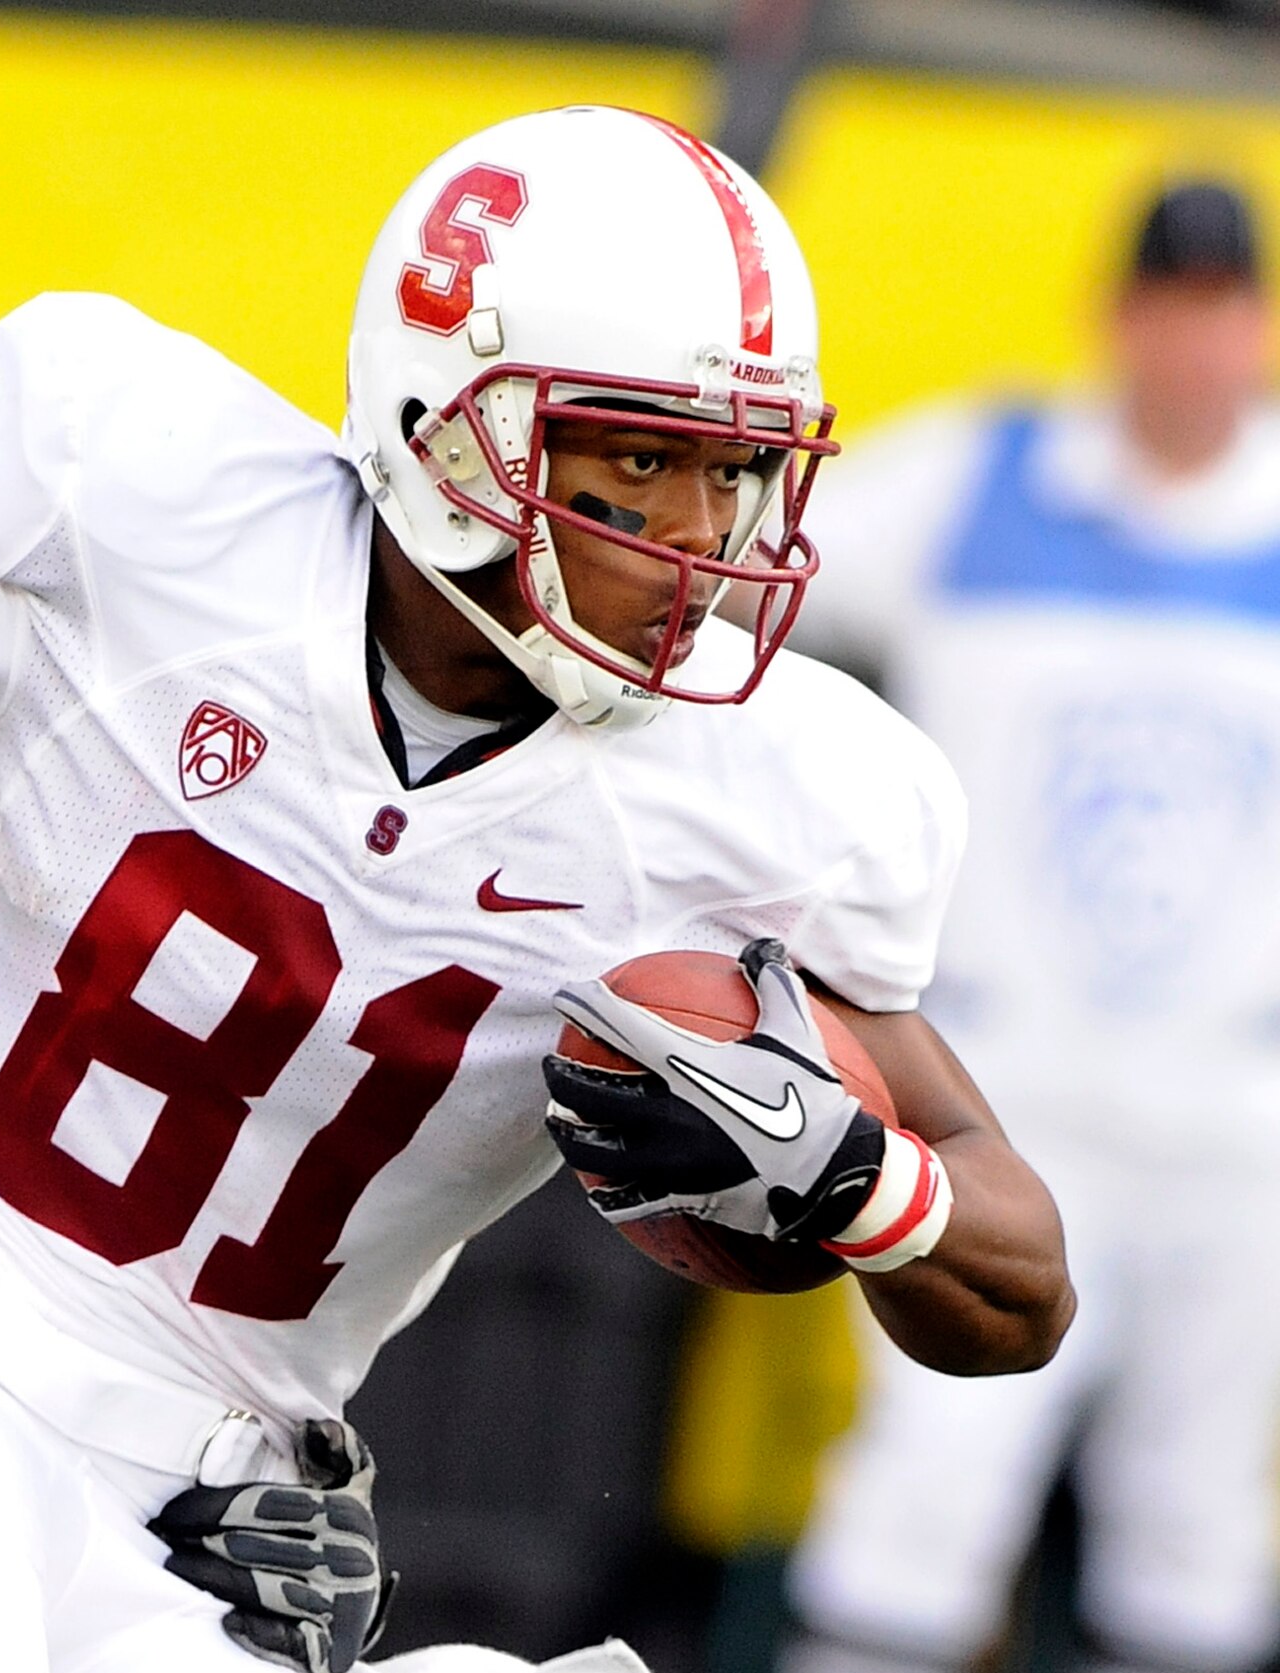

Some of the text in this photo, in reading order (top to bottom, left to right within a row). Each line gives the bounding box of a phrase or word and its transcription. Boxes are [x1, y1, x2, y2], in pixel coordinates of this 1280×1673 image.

[184, 744, 229, 786] 10
[185, 706, 263, 778] PAC
[365, 804, 409, 856] S
